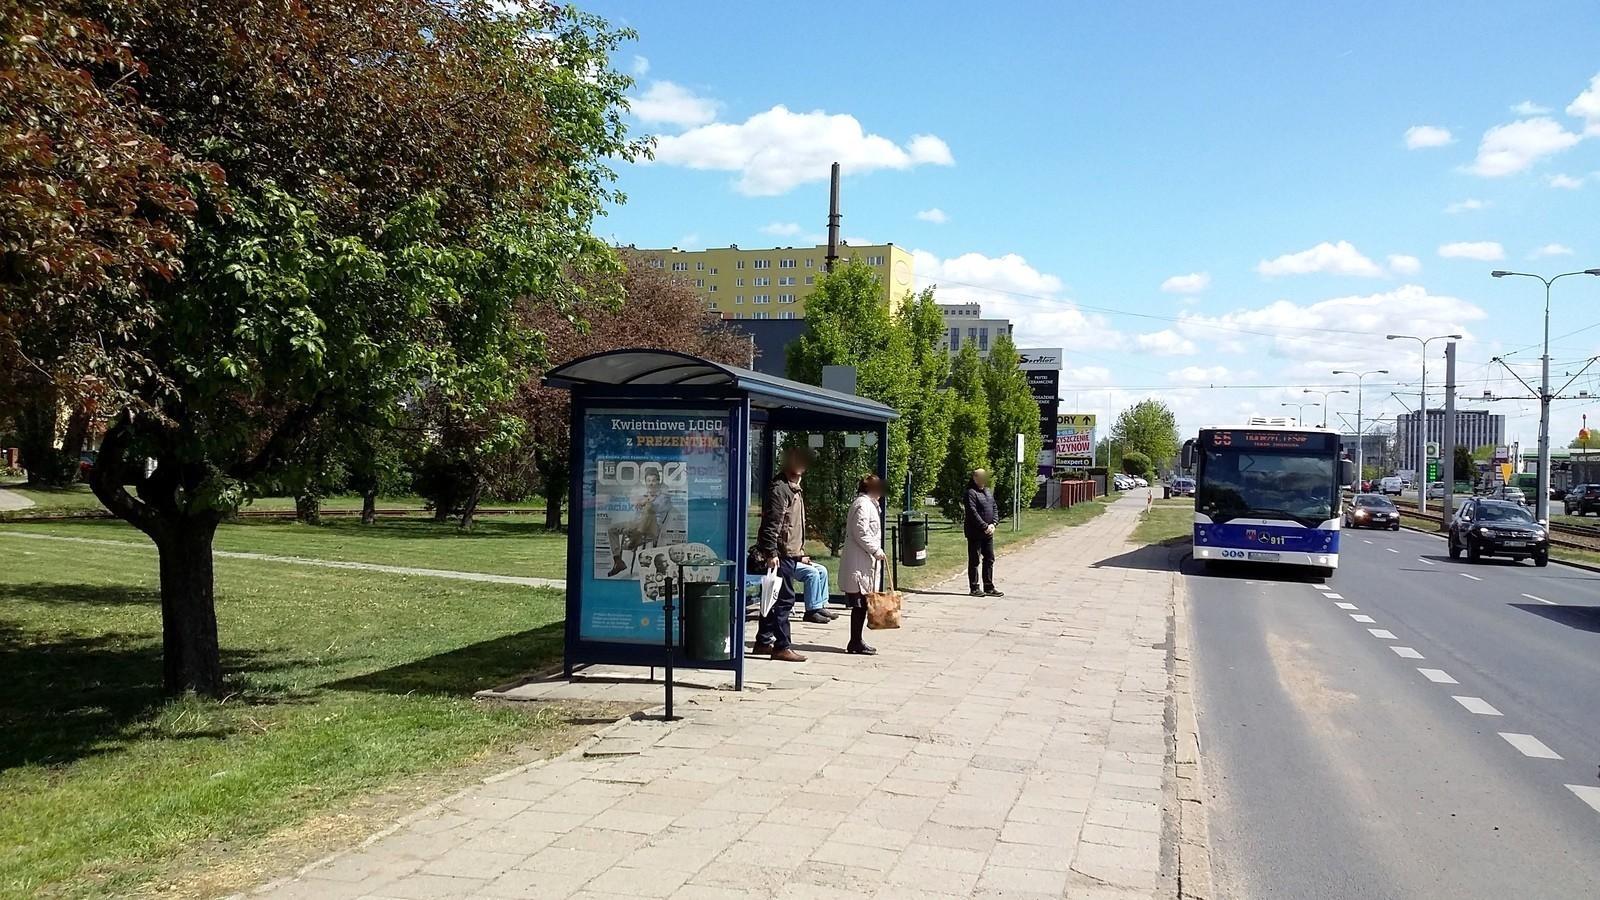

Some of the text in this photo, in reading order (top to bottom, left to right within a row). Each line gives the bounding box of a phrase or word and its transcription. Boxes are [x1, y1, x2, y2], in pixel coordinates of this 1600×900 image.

[1057, 416, 1076, 424] ORY
[611, 419, 723, 431] Kwietniowe LOGO
[626, 437, 633, 446] z
[1270, 536, 1285, 545] 911
